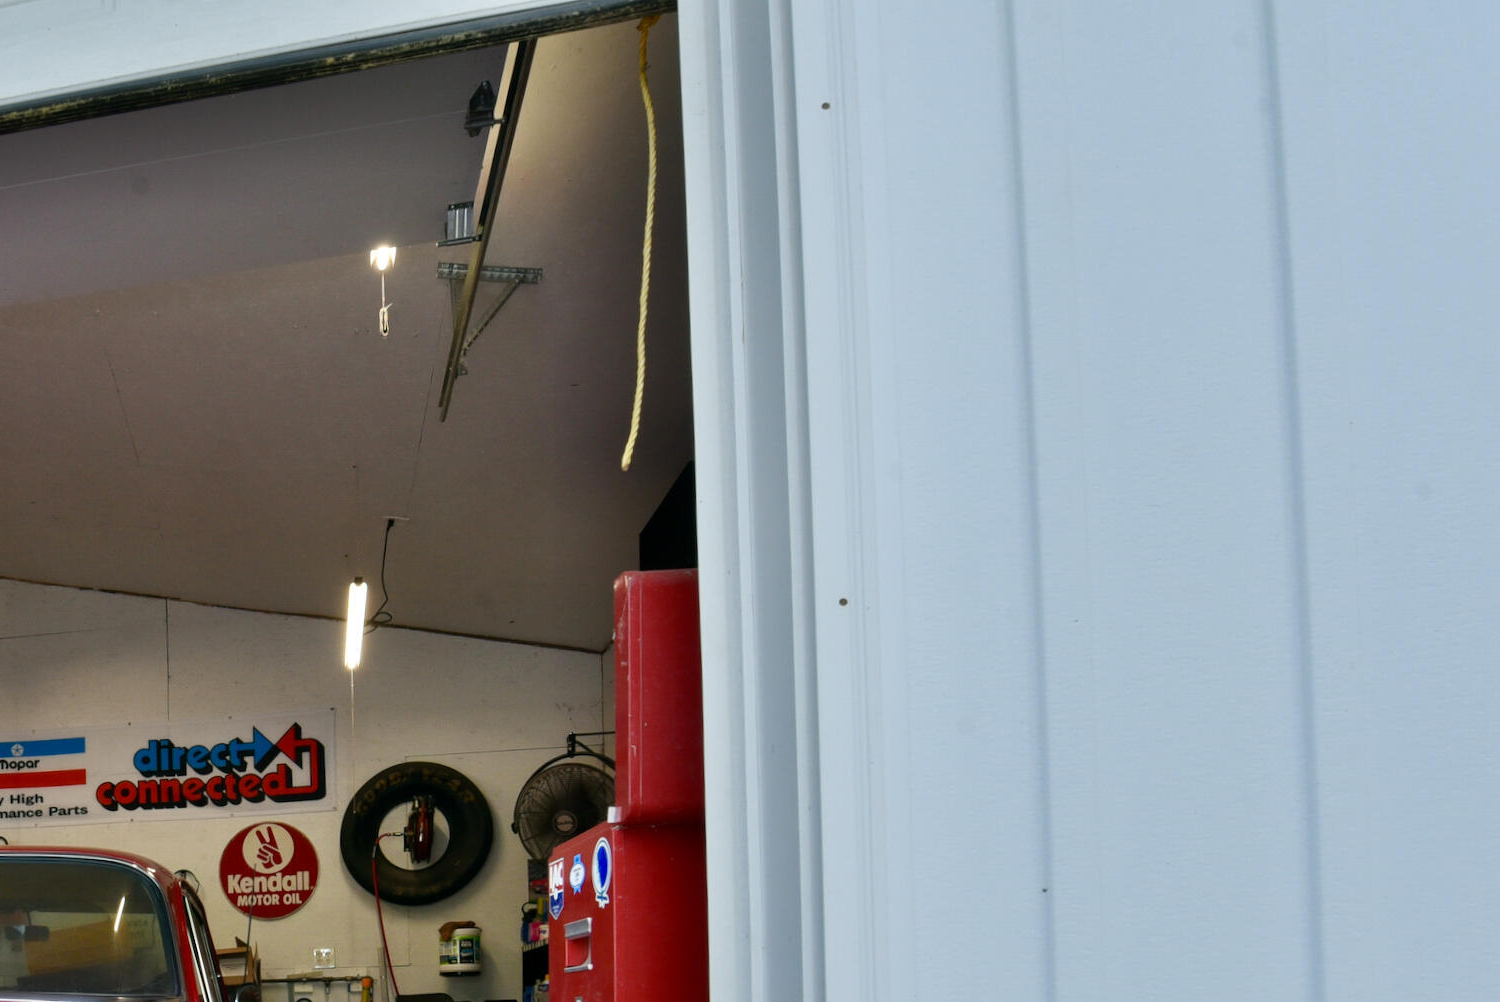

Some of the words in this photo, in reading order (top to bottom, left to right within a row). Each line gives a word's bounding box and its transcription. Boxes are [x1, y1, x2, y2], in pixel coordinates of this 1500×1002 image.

[96, 763, 297, 811] connected
[10, 794, 44, 805] High
[49, 806, 88, 817] Parts
[227, 871, 310, 894] Kendall
[237, 894, 279, 907] MOTOR
[283, 893, 302, 905] OIL
